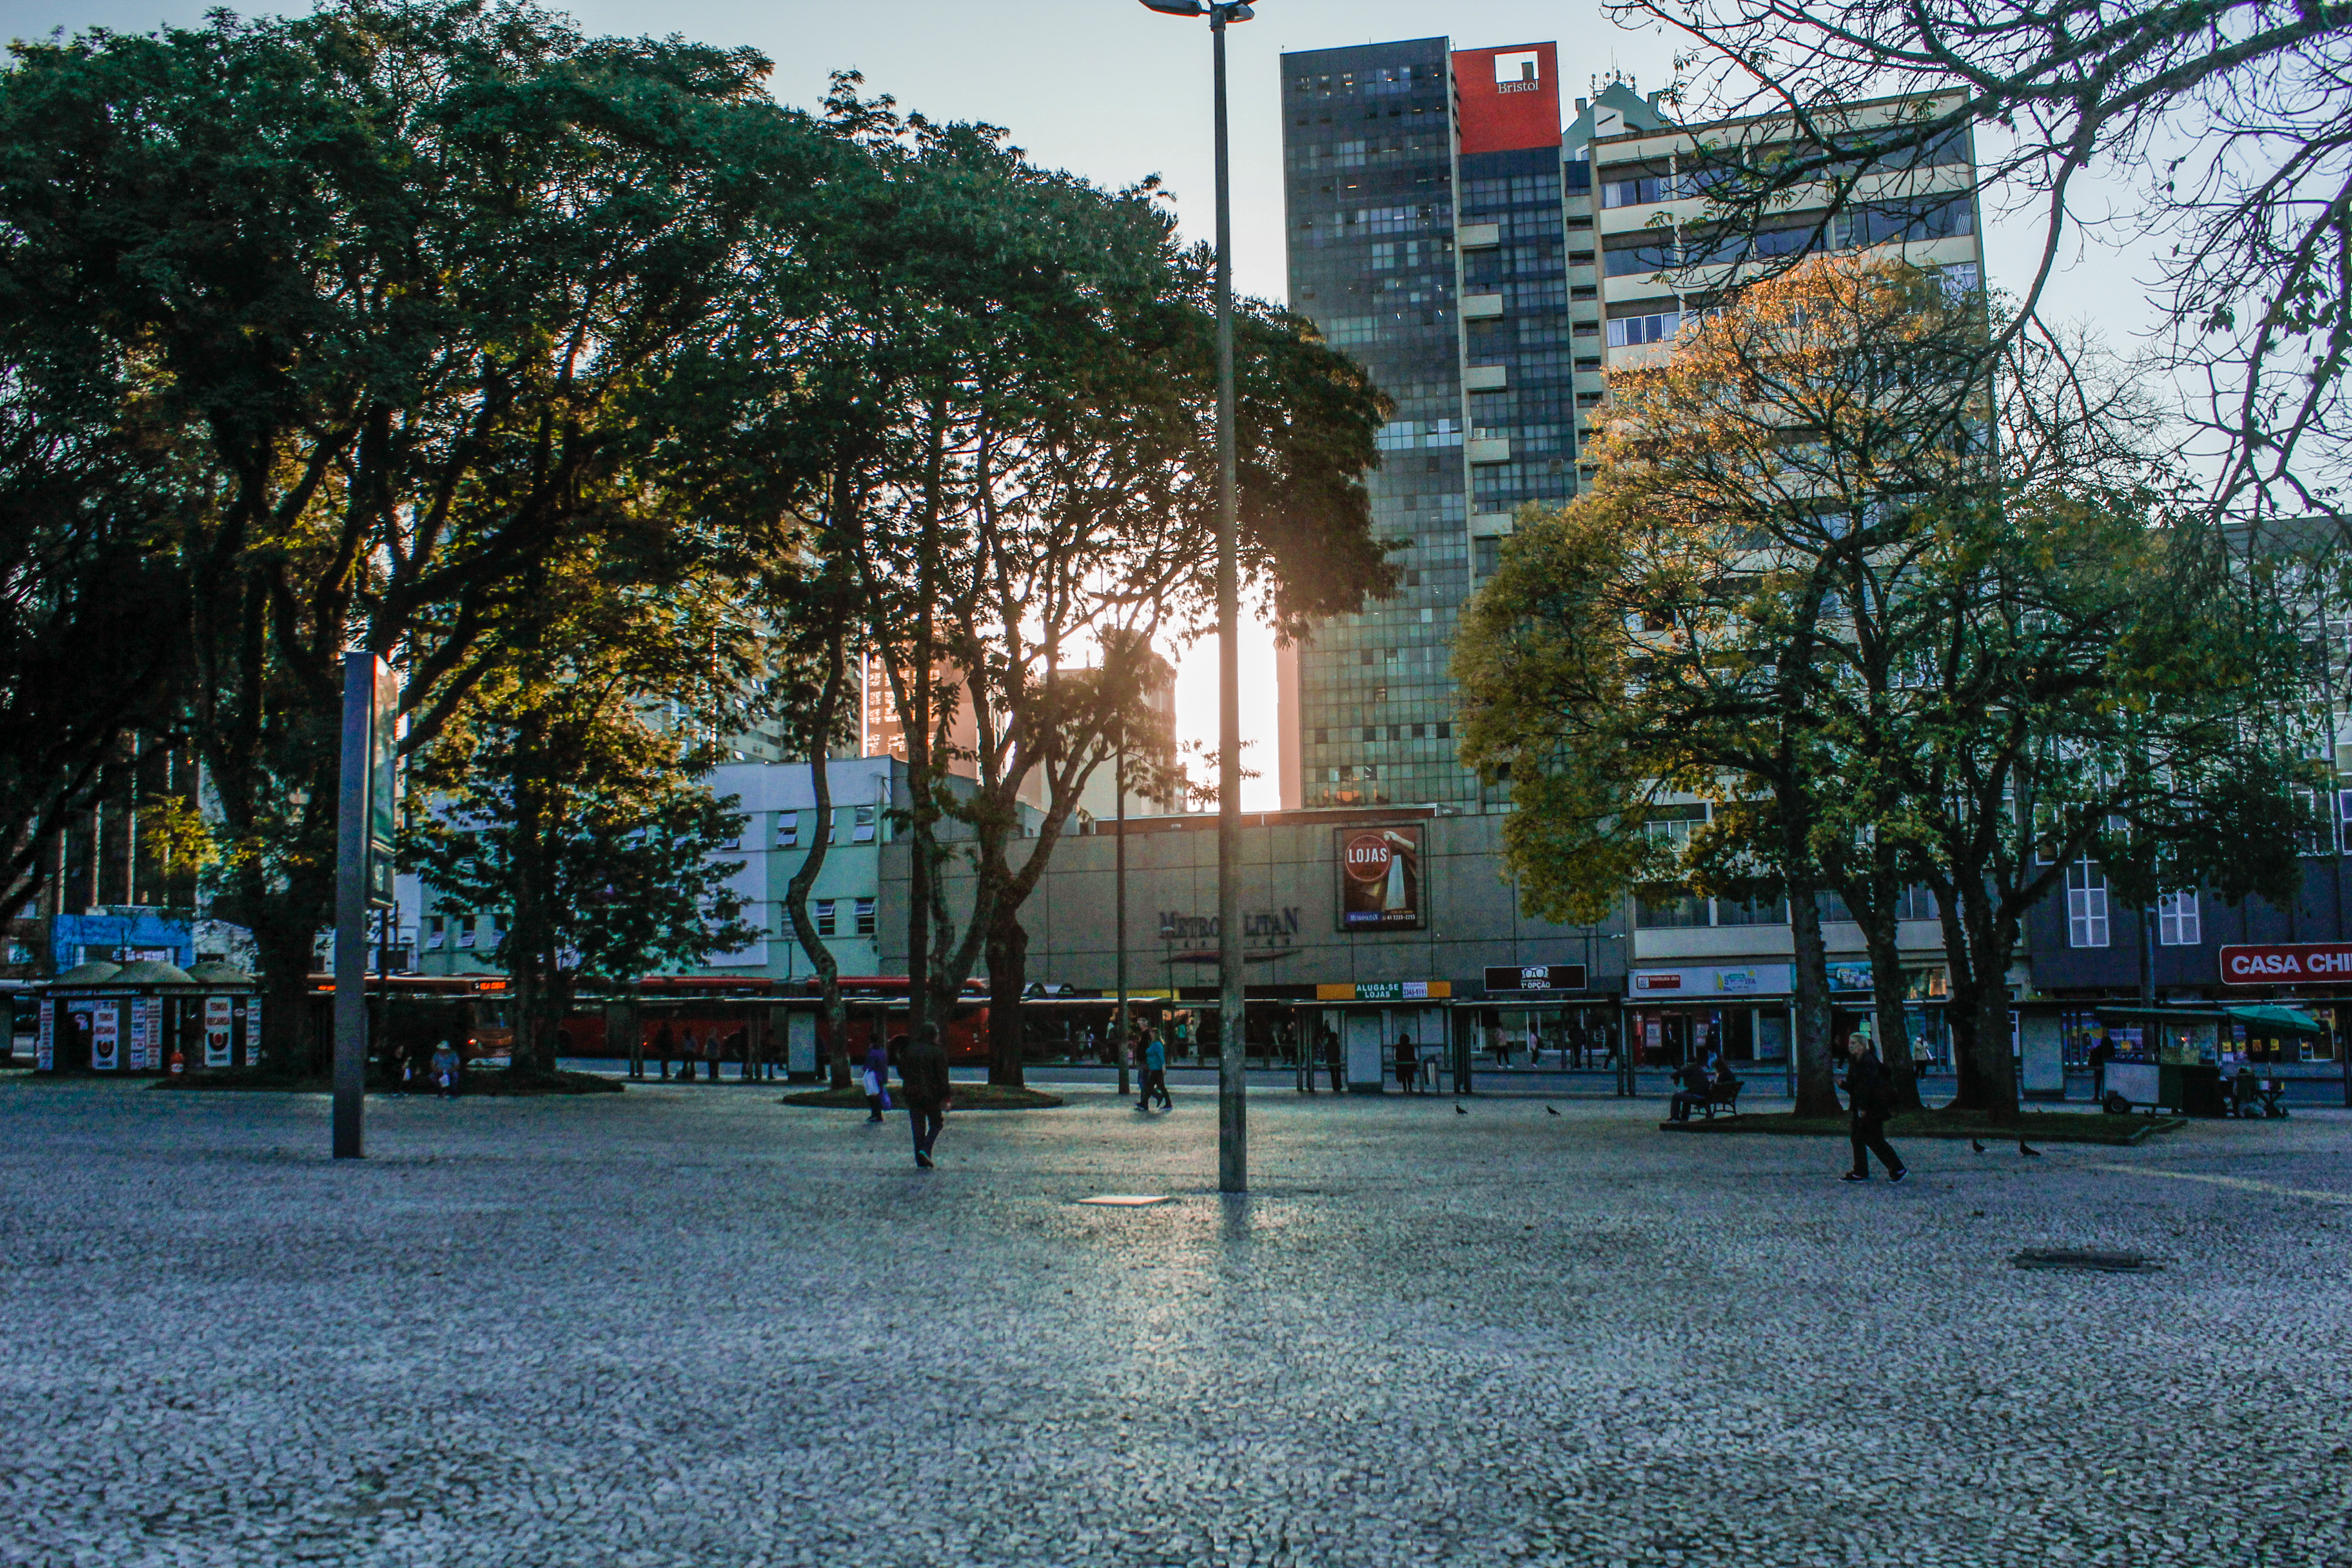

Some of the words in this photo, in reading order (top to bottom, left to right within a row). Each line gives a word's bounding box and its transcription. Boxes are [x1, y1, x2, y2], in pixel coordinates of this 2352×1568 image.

[1498, 80, 1538, 93] Bristol
[1349, 848, 1387, 863] LOJAS
[2231, 955, 2302, 975] CASA
[2307, 953, 2352, 973] CHI
[1528, 980, 1551, 990] OPÇÃO
